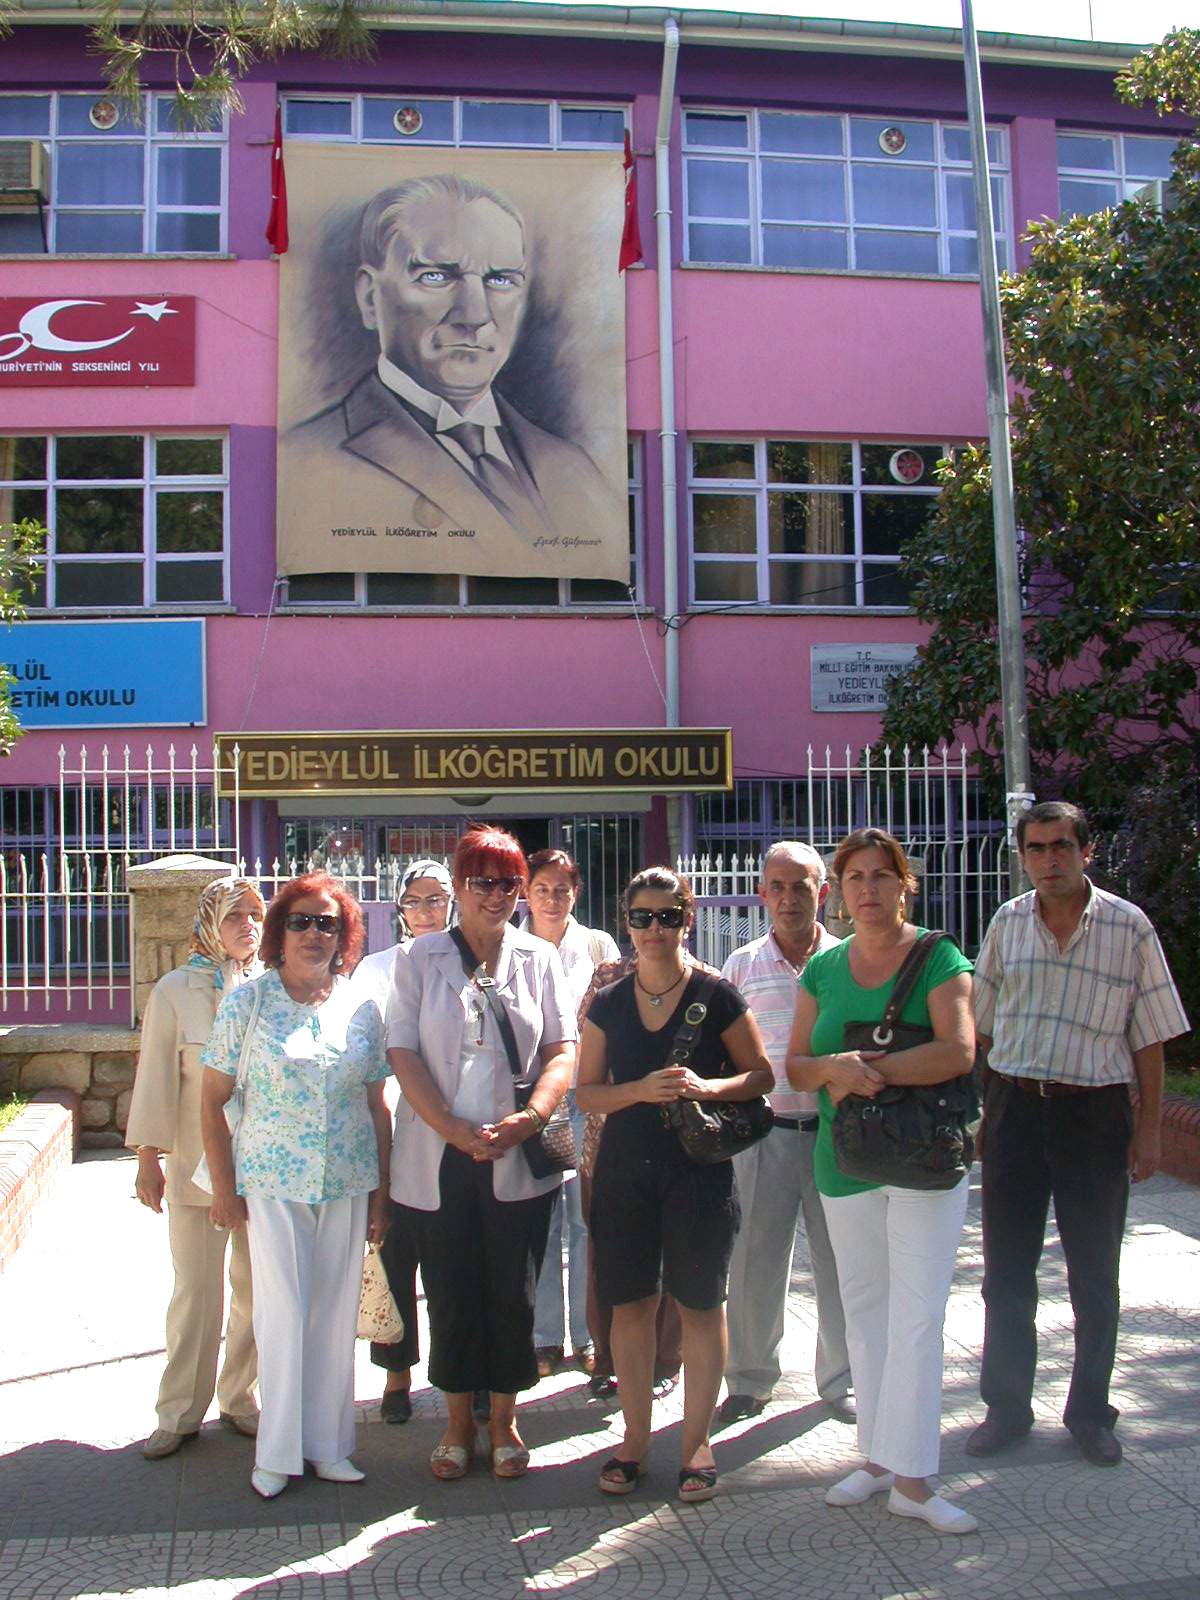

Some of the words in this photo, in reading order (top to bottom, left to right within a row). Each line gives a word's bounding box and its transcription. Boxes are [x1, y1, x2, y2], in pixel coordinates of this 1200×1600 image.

[0, 360, 63, 372] URİYETİ'NİN
[72, 360, 131, 372] SEKSENİNCİ
[138, 361, 160, 372] YILI
[331, 526, 377, 537] YEDİEYLÜL
[385, 526, 438, 538] İLKÖĞRETİM
[447, 529, 476, 538] OKULU
[819, 661, 842, 673] MİLLİ
[845, 661, 870, 673] EĞİTİM
[839, 676, 887, 689] YEDİEYL
[10, 686, 59, 708] ETİM
[66, 688, 135, 707] OKULU
[828, 690, 875, 704] İLKÖĞRETİM
[226, 745, 399, 781] YEDİEYLÜL
[414, 743, 604, 780] İLKÖĞRETİM
[615, 747, 720, 777] OKULU
